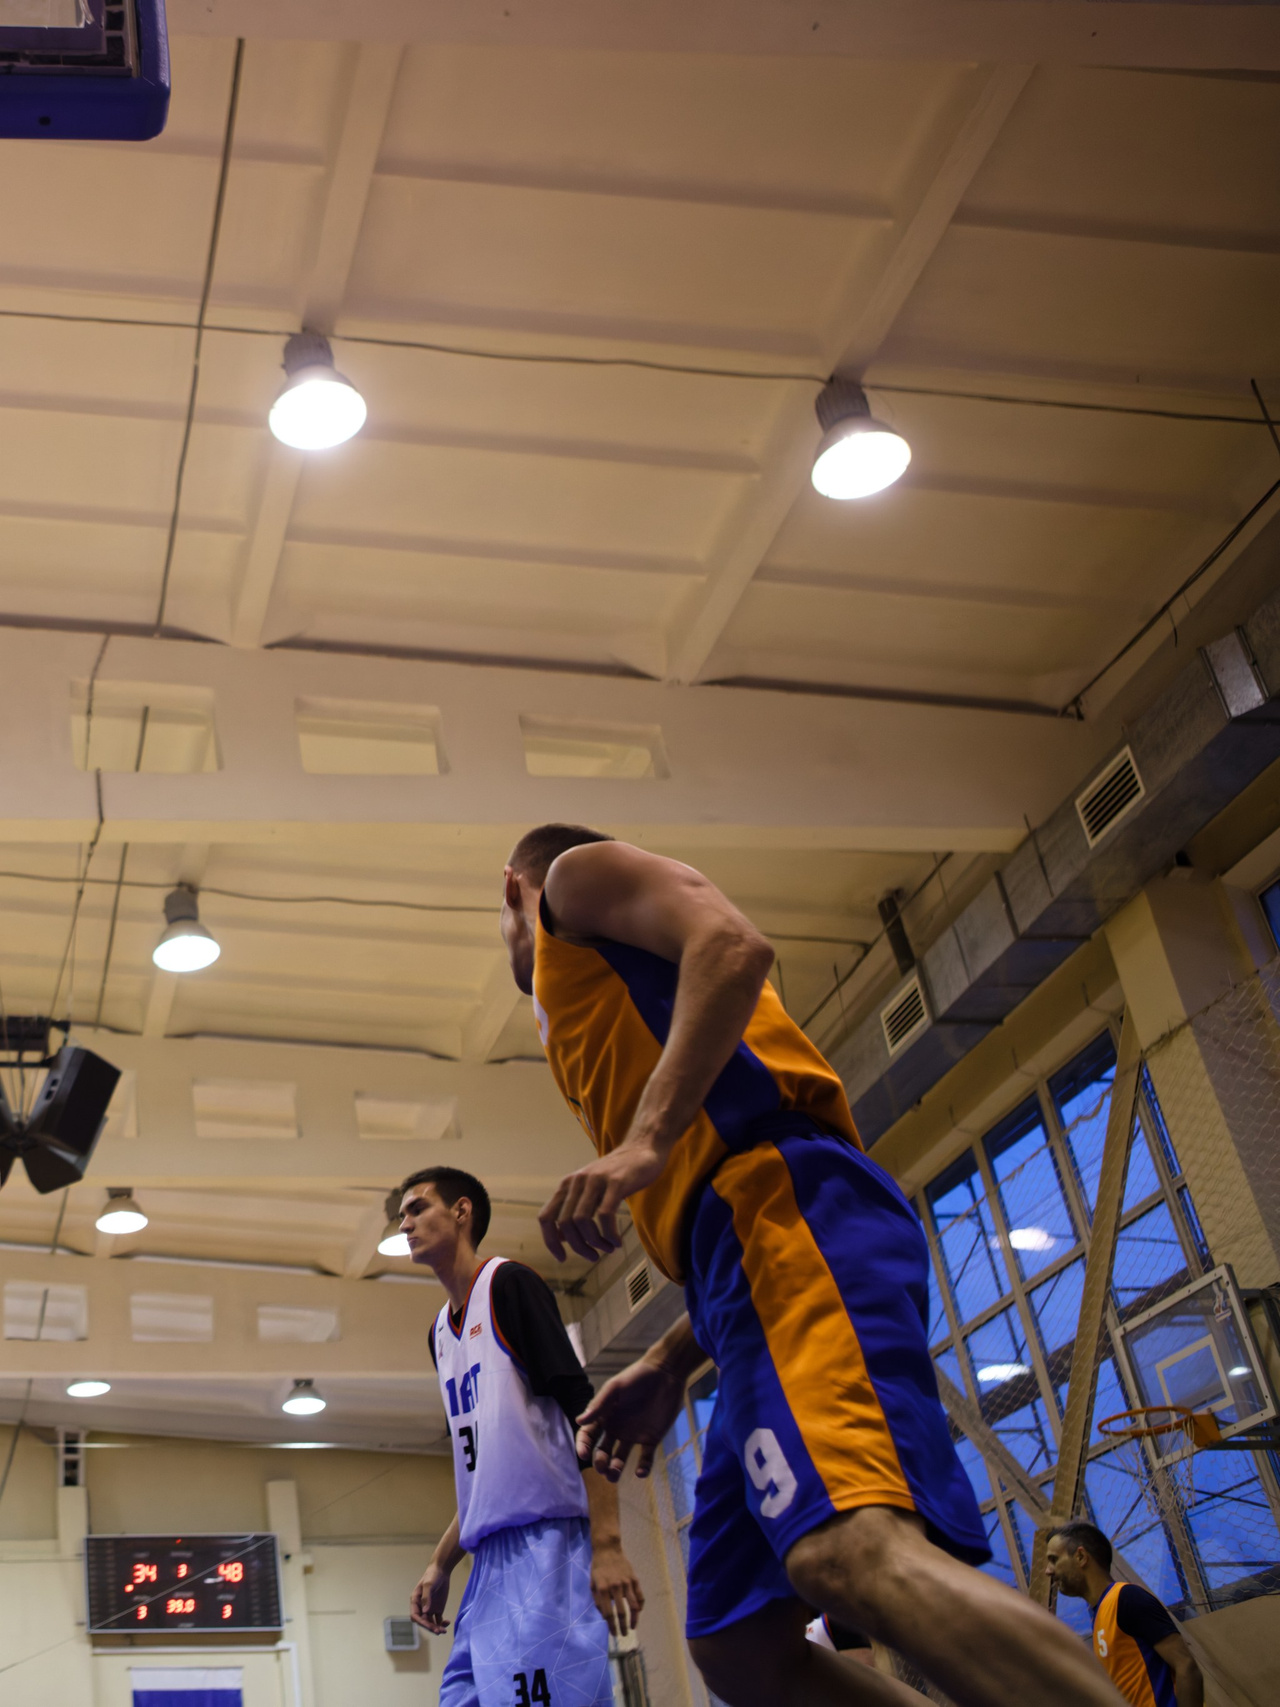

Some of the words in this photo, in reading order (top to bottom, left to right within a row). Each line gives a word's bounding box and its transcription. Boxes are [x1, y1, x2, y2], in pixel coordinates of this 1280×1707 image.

[459, 1420, 478, 1473] 3
[744, 1427, 798, 1519] 9
[133, 1563, 158, 1584] 34
[177, 1563, 188, 1578] 3
[218, 1562, 244, 1583] 48
[136, 1605, 148, 1620] 3
[222, 1604, 233, 1619] 3
[1097, 1629, 1108, 1657] 5
[513, 1668, 551, 1707] 34
